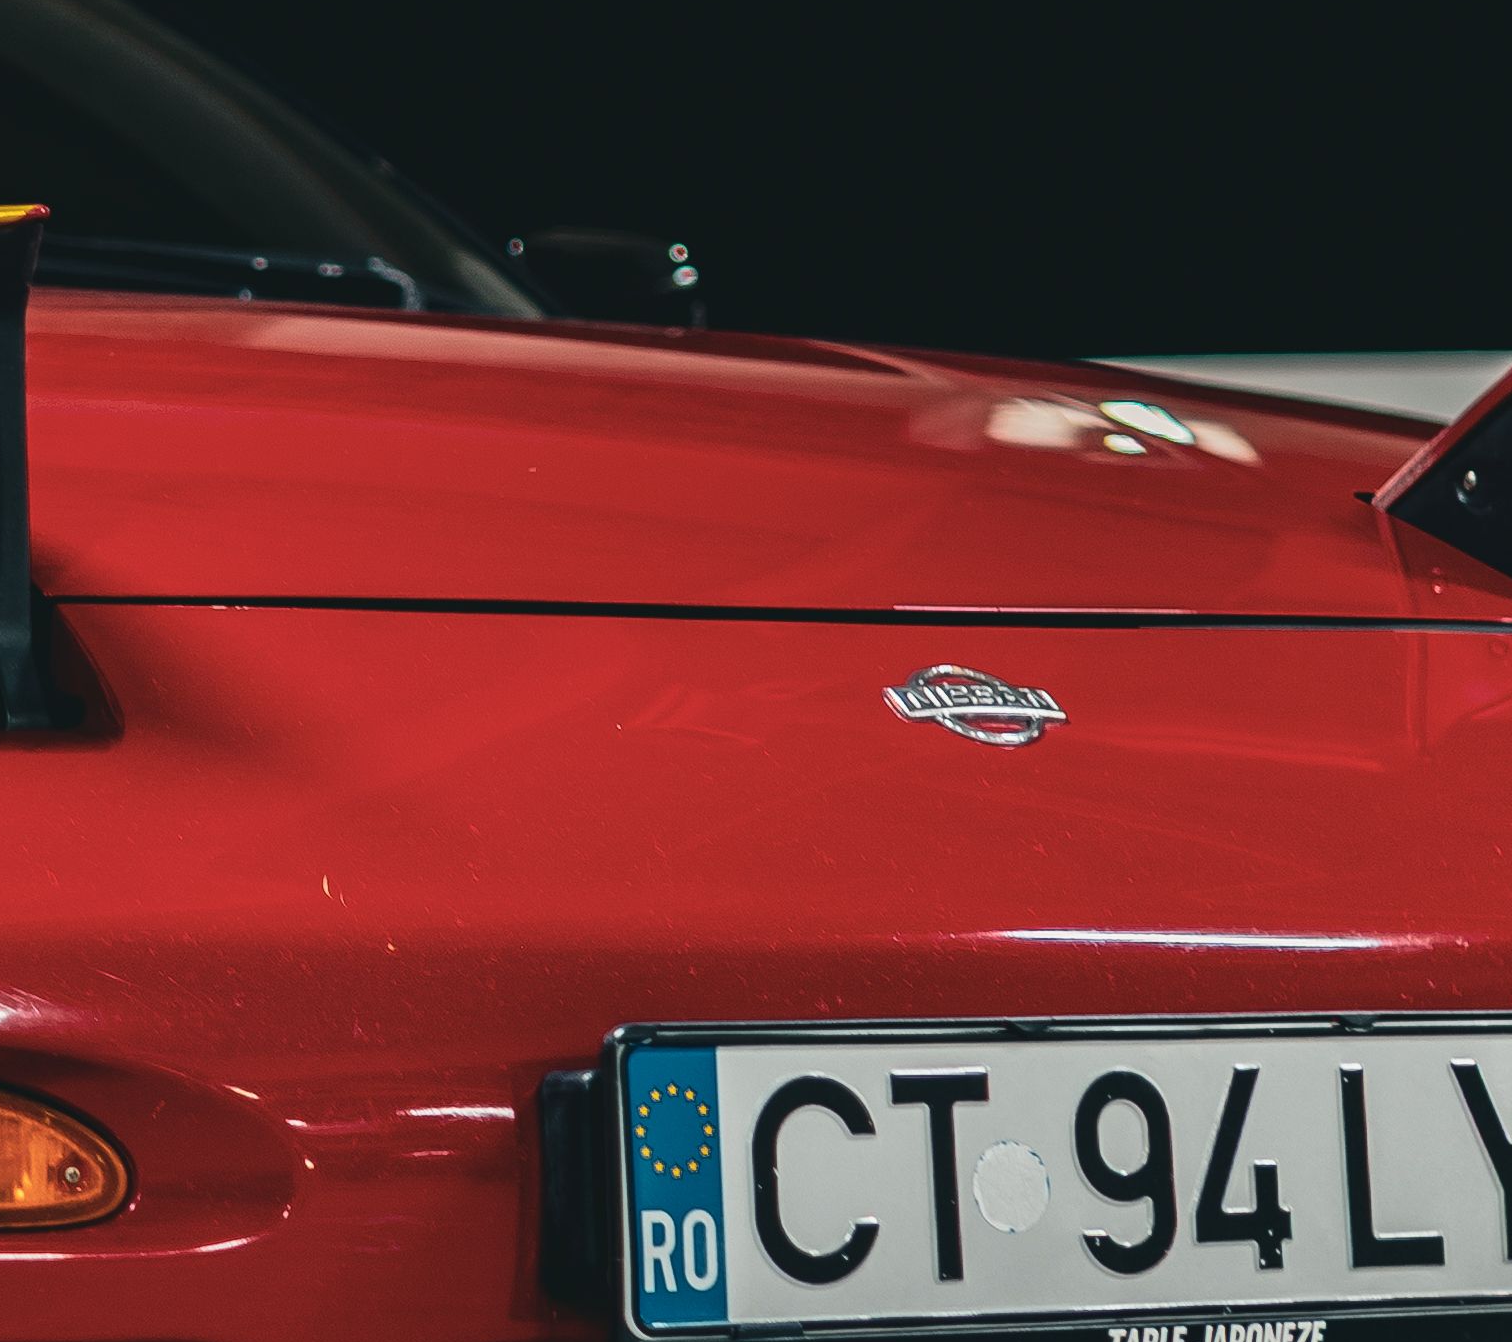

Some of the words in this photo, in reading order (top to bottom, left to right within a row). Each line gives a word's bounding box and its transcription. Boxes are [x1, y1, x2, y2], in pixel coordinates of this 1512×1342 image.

[640, 1208, 719, 1293] RO
[750, 1065, 988, 1286] CT
[1074, 1062, 1294, 1275] 94
